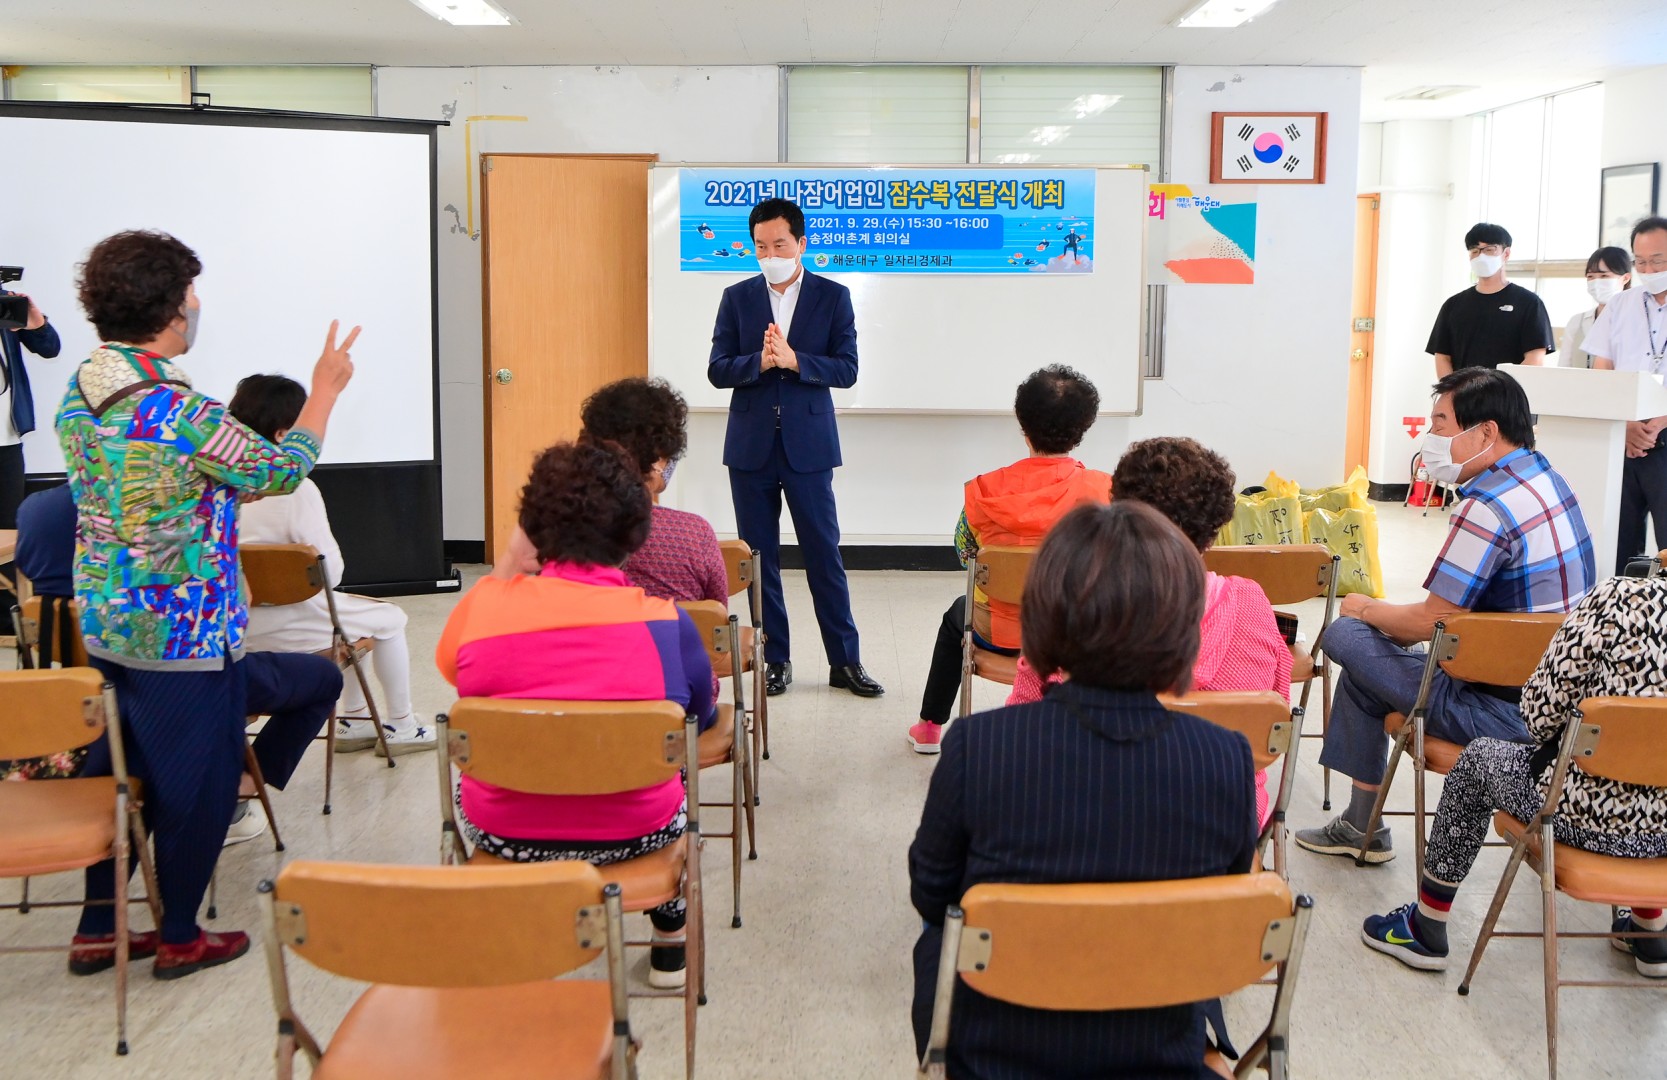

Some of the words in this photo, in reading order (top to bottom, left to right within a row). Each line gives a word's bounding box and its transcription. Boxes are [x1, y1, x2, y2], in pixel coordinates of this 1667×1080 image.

[706, 181, 776, 205] 2021년
[783, 180, 883, 207] 나잠어업인
[889, 181, 951, 208] 잠수복
[956, 181, 1016, 208] 전달식
[1023, 181, 1063, 208] 개최
[809, 217, 844, 229] 2021.
[847, 217, 859, 229] 9.
[863, 217, 905, 229] 29.(수)
[907, 217, 942, 229] 15:30
[945, 217, 989, 229] ~16:00
[809, 232, 870, 245] 송정어촌계
[873, 232, 911, 245] 회의실
[832, 254, 879, 267] 해운대구
[884, 254, 952, 267] 일자리경제과
